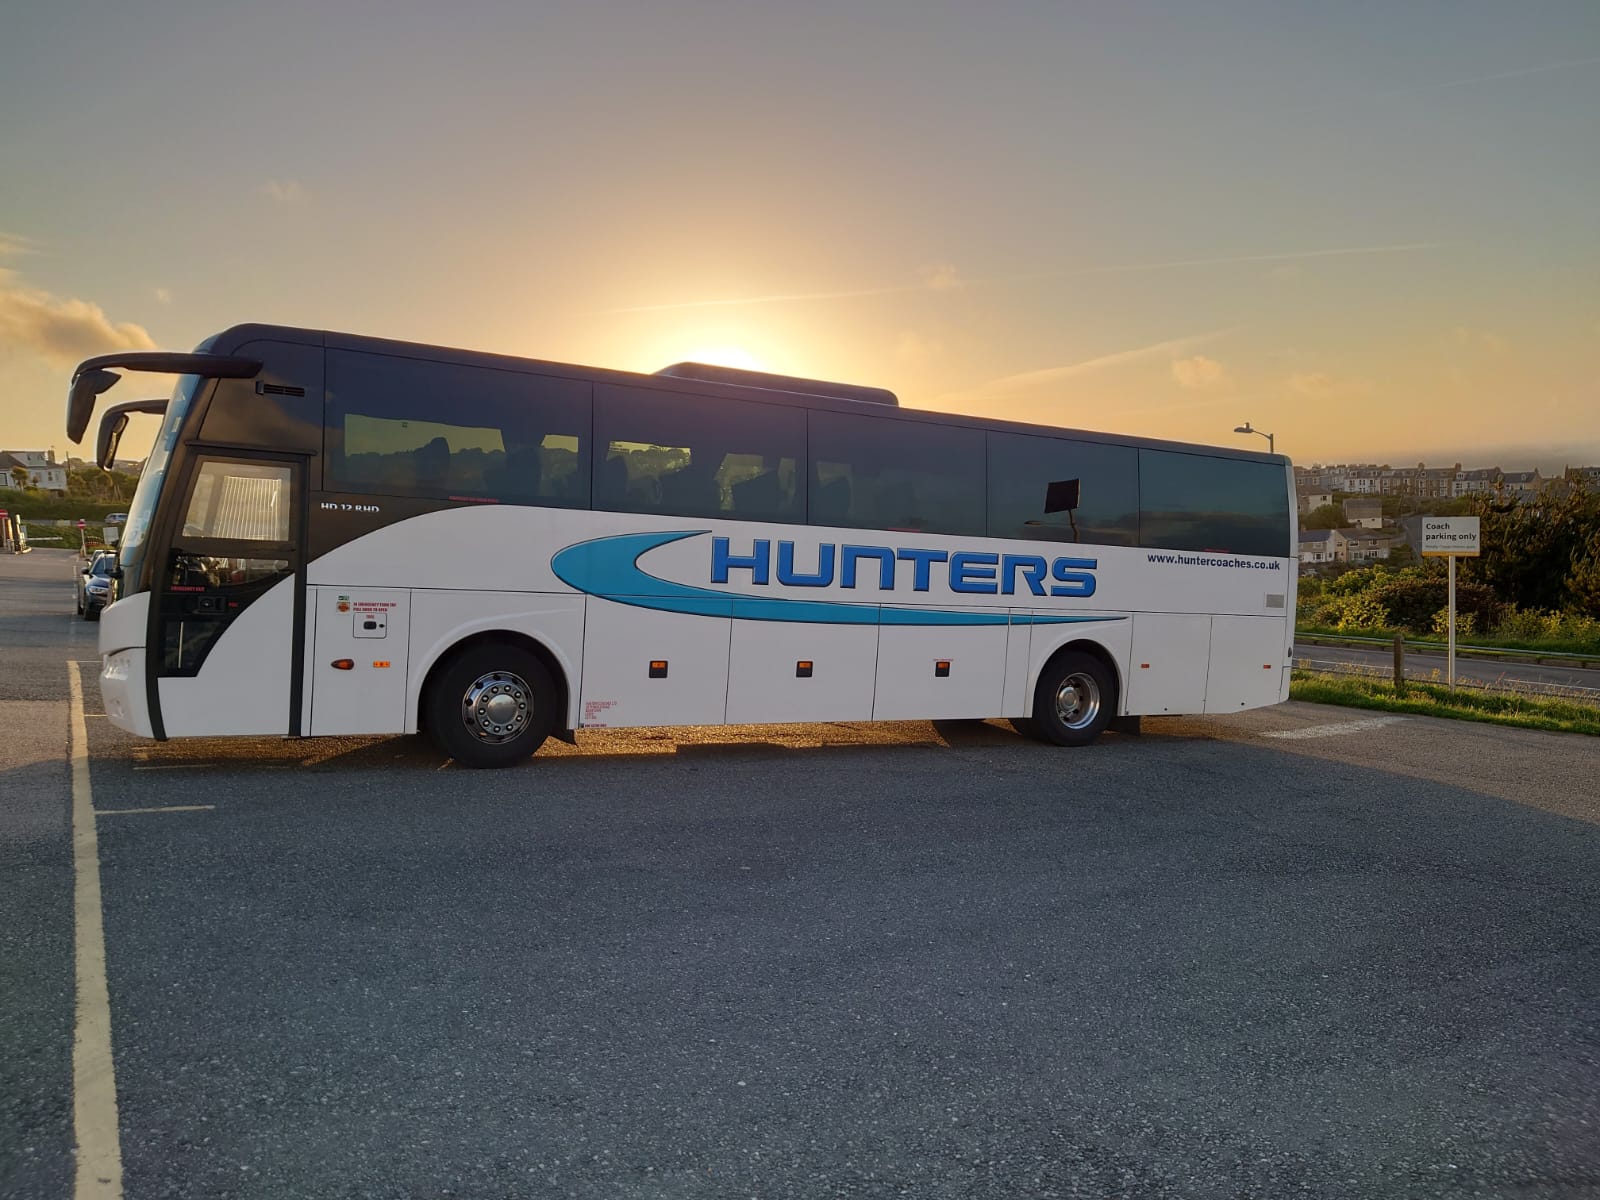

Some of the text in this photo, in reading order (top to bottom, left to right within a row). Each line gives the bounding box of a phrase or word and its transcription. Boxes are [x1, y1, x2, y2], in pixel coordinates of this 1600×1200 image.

[320, 502, 380, 513] HD 12 RHD
[1425, 533, 1477, 541] parking only
[710, 536, 1098, 598] HUNTERS
[1147, 554, 1280, 570] www.huntercoaches.co.uk
